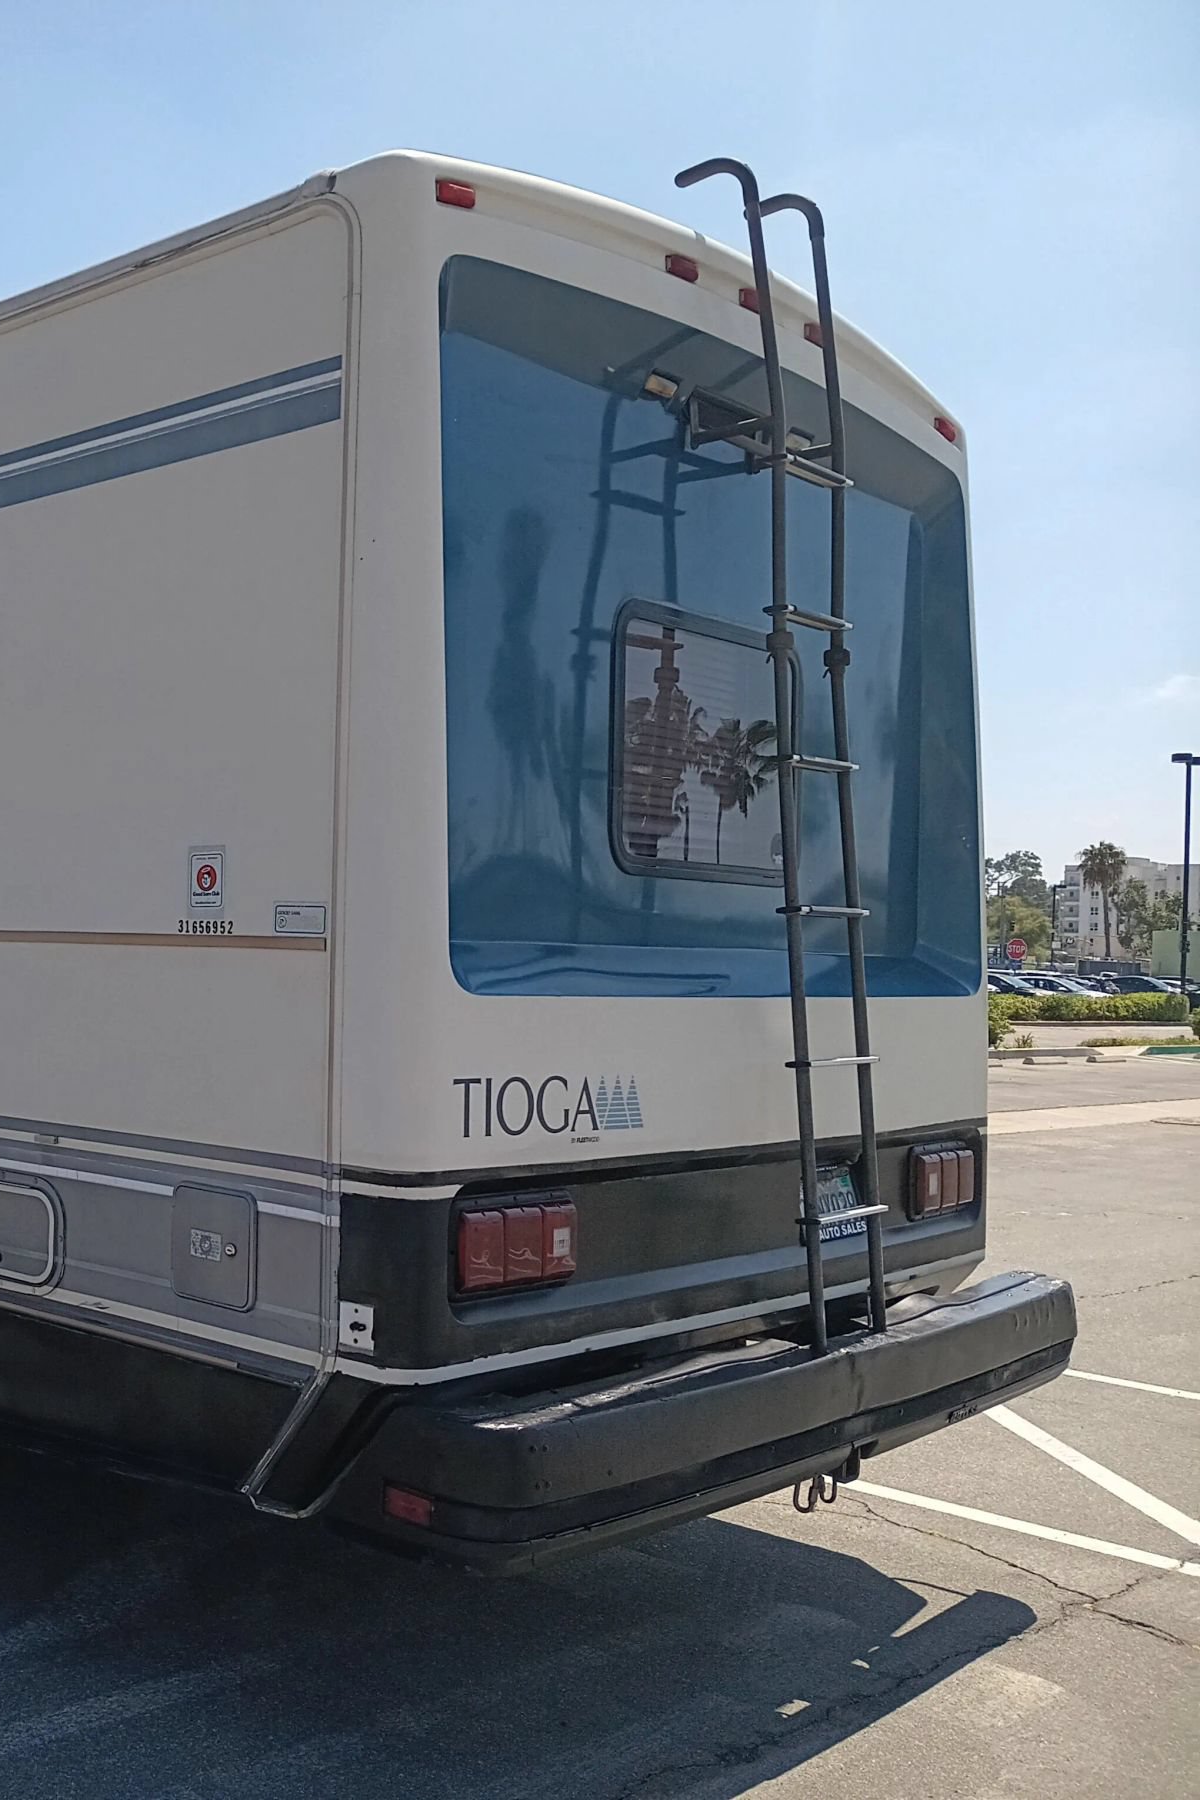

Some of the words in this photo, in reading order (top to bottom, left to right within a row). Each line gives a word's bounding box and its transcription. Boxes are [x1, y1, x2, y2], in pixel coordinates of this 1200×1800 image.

[177, 919, 234, 935] 31656952
[1007, 944, 1026, 953] STOP
[453, 1075, 599, 1138] TIOGA
[819, 1226, 840, 1241] AUTO
[841, 1220, 868, 1236] SALES
